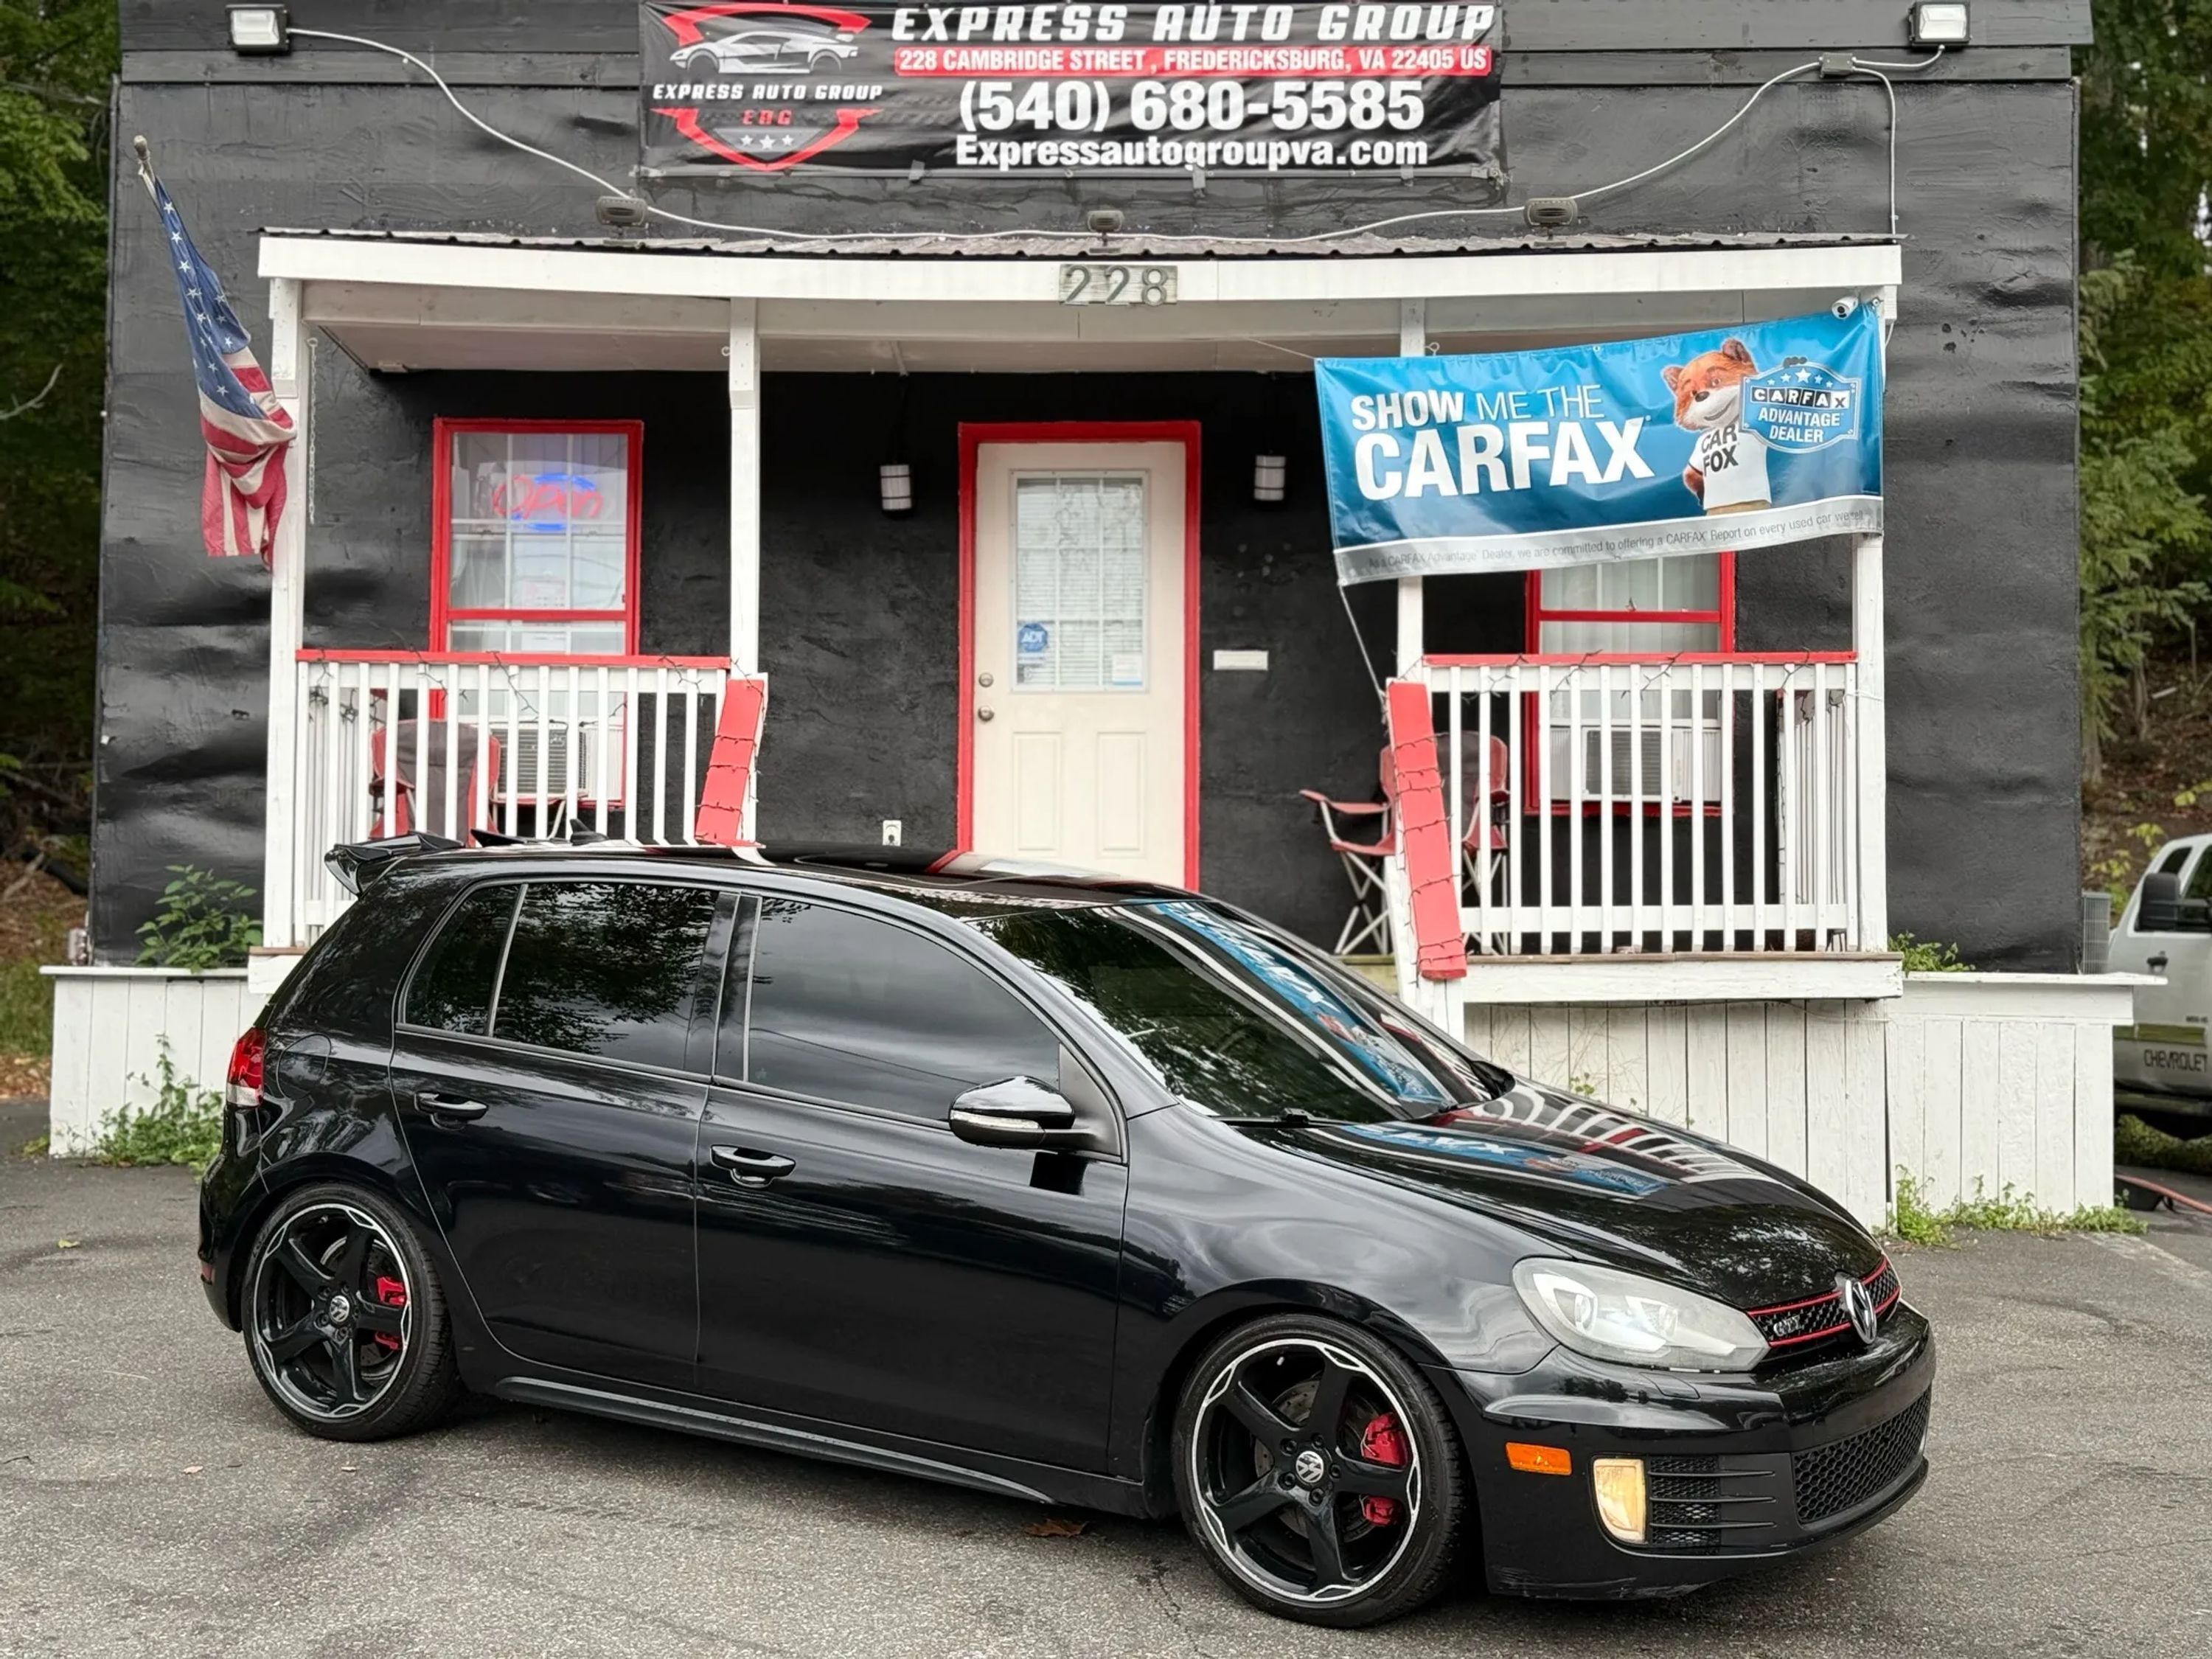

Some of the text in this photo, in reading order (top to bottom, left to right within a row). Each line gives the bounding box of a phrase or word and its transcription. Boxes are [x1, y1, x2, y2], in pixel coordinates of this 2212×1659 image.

[891, 5, 1495, 41] EXPRESS AUTO GROUP
[900, 49, 937, 71] 228
[943, 49, 1063, 71] CAMBRIDGE
[1164, 49, 1352, 73] FREDERICKSBURG,
[1359, 49, 1385, 70] VA
[1392, 49, 1454, 70] 22405
[1461, 49, 1487, 70] US
[653, 83, 883, 100] EXPRESS AUTO GROUP
[960, 80, 1425, 132] (540) 680-5585
[957, 134, 1428, 171] Expressautogroupva.com
[1065, 265, 1168, 307] 228
[1351, 384, 1605, 431] SHOW ME THE
[1753, 387, 1848, 408] CARFAX
[1758, 407, 1840, 426] ADVANTAGE
[1701, 424, 1737, 453] CAR
[1770, 425, 1824, 442] DEALER
[1354, 415, 1656, 501] CARFAX
[1703, 445, 1739, 477] FOX
[1388, 553, 1426, 567] CARFAX
[1534, 549, 1549, 557] are
[1552, 540, 1604, 556] committed
[1606, 541, 1615, 551] to
[1618, 536, 1654, 550] offering
[1666, 531, 1705, 544] CARFAX
[1711, 526, 1741, 542] Report
[1745, 528, 1756, 538] on
[1759, 523, 1786, 536] every
[1790, 518, 1813, 529] used
[1816, 514, 1832, 525] car
[1021, 630, 1046, 643] ADT
